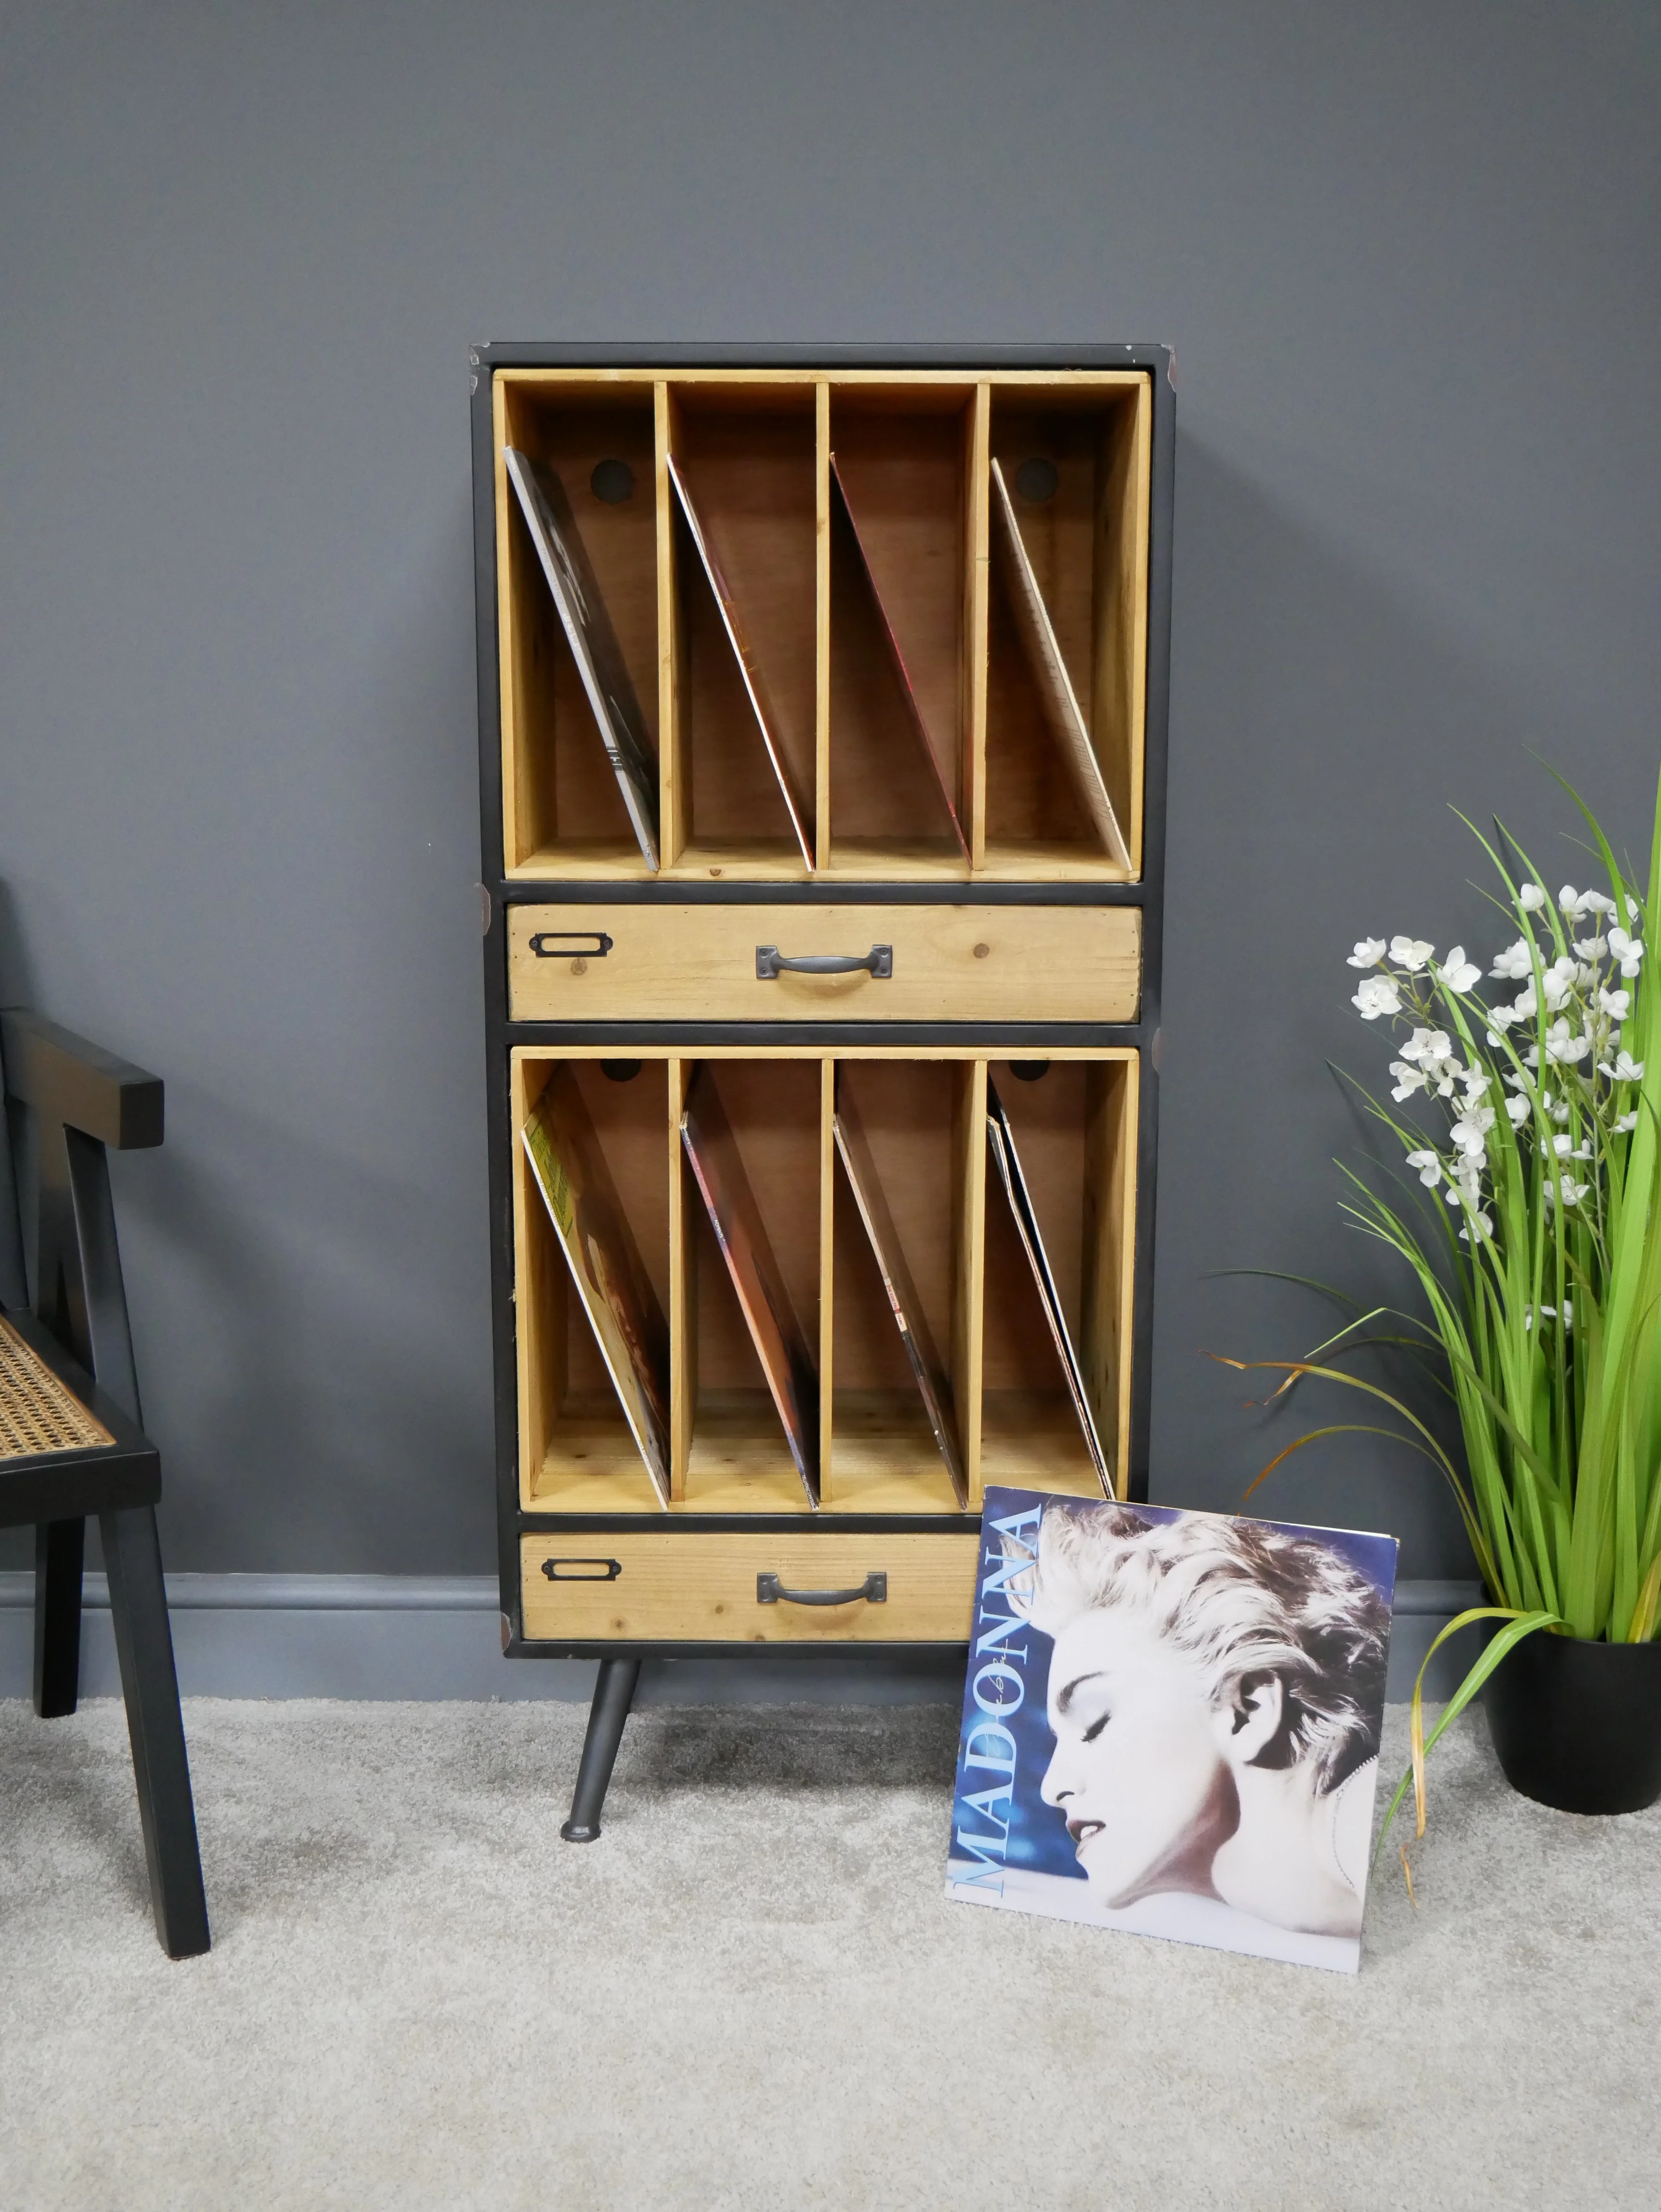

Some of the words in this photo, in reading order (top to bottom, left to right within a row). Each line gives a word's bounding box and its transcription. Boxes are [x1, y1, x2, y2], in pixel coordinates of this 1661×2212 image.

[551, 1211, 559, 1226] DENVER
[713, 1219, 724, 1238] MOMENTS
[801, 1474, 811, 1493] TELLYDISC
[953, 1503, 1042, 1898] MADONNA
